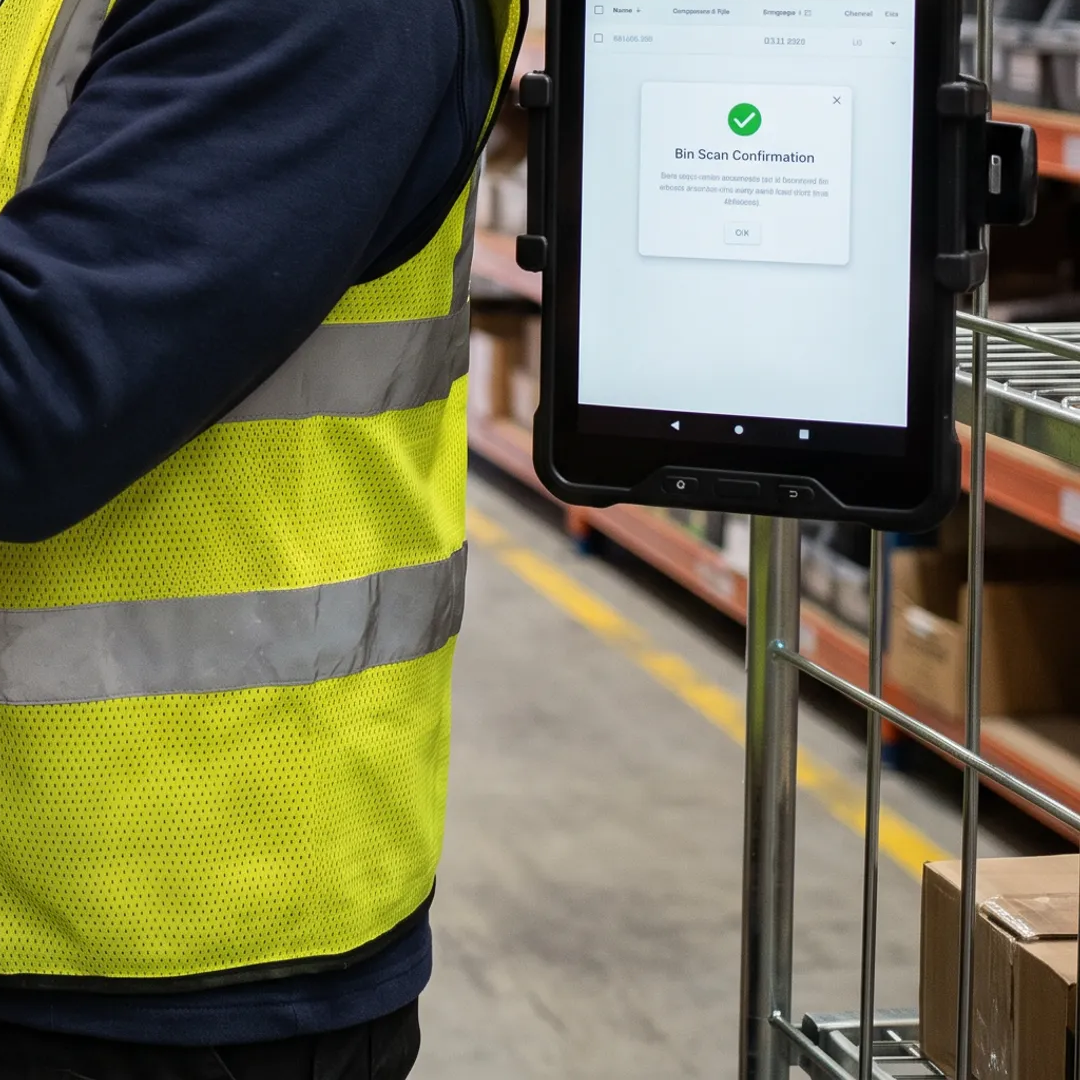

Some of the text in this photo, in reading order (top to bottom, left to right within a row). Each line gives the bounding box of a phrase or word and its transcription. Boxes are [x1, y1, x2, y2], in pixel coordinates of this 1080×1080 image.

[674, 147, 815, 164] Bin Scan Confirmation
